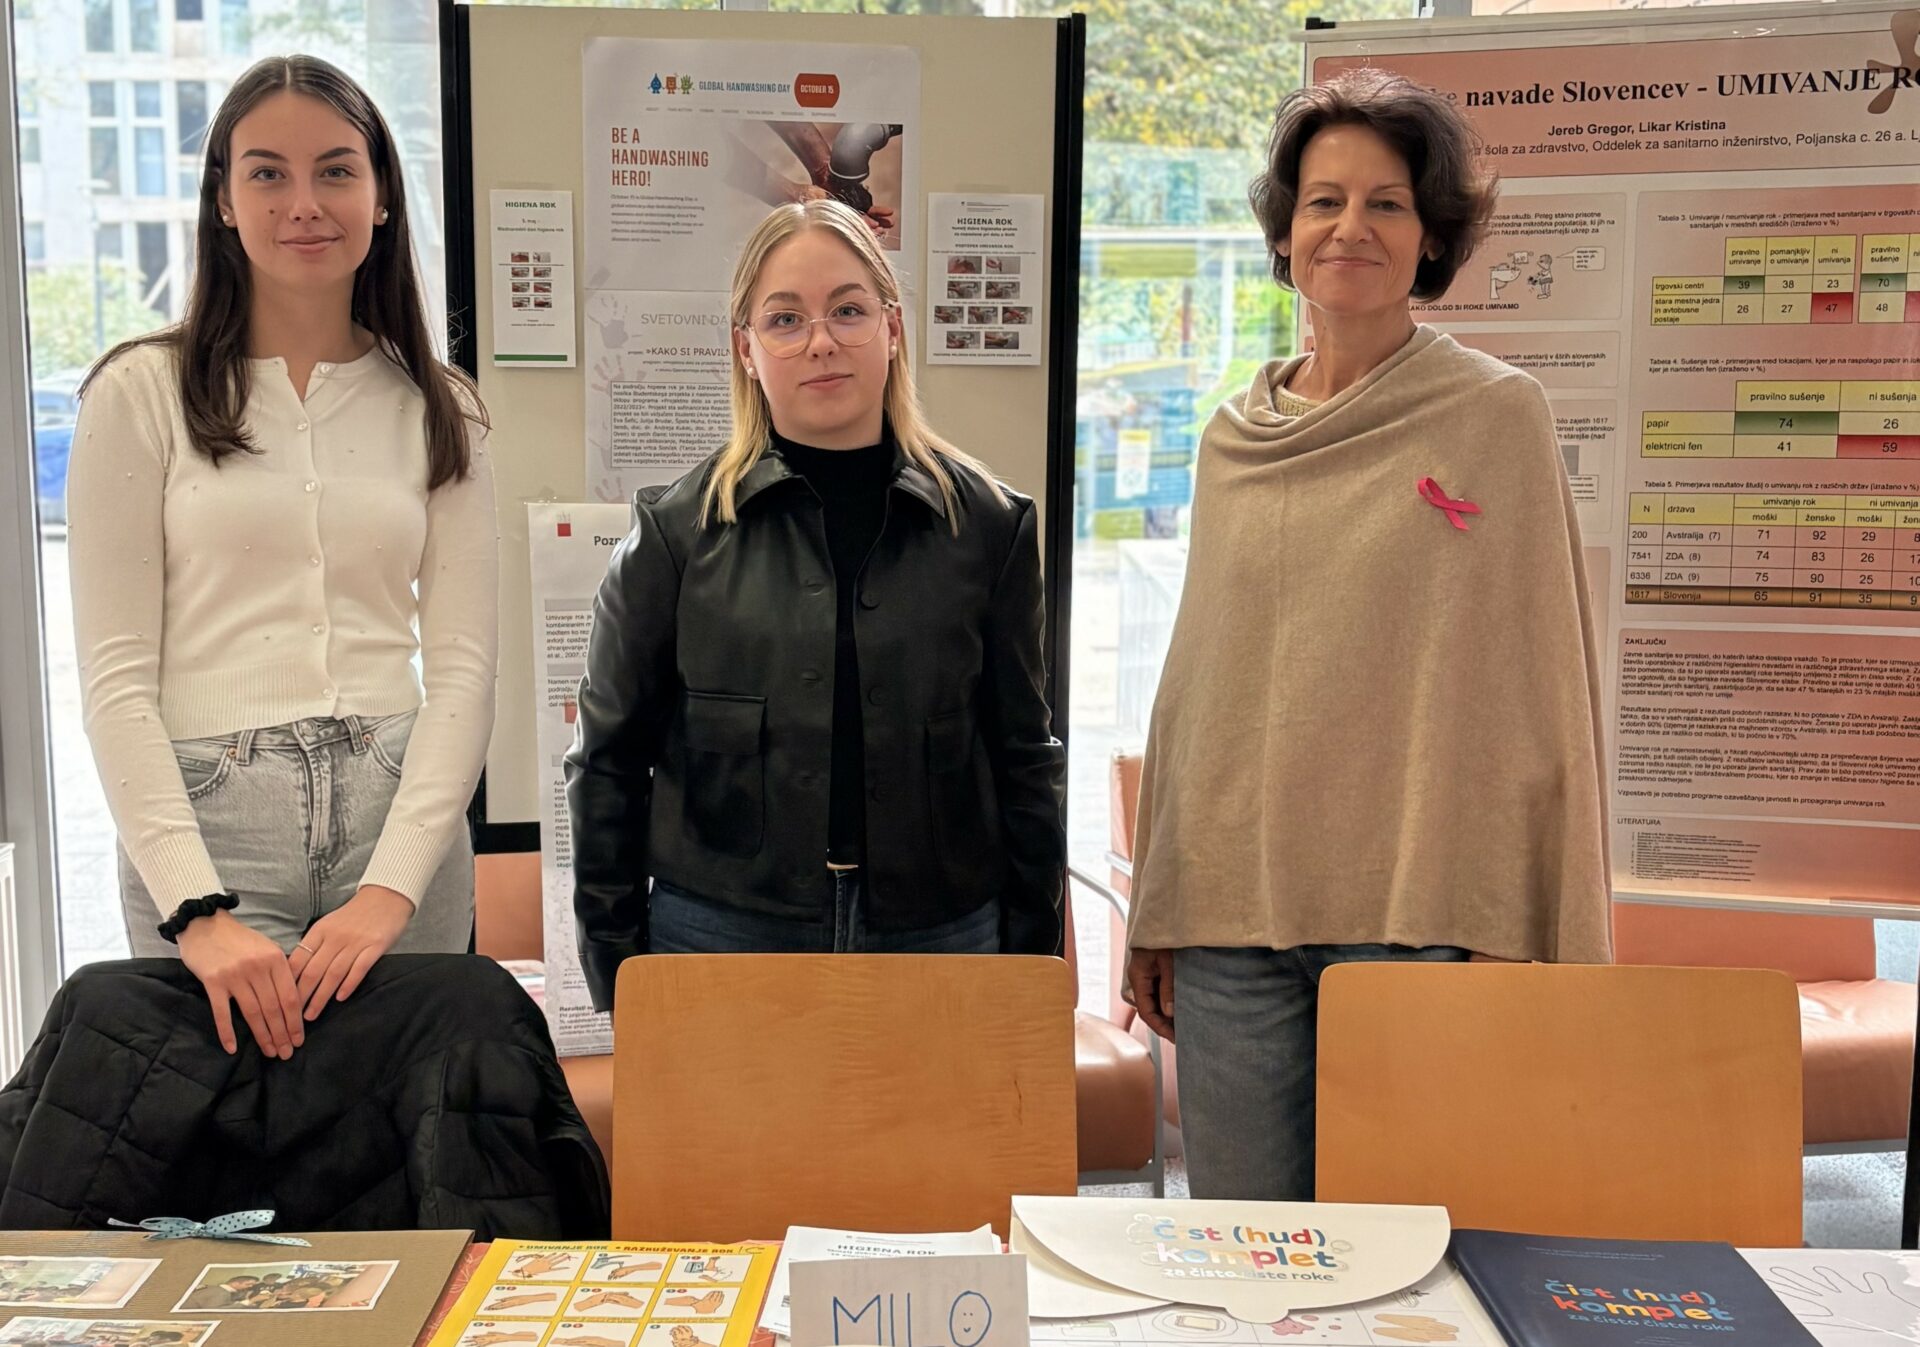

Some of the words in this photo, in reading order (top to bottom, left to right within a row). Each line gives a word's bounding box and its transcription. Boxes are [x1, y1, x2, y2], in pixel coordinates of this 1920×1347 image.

[699, 81, 724, 91] GLOBAL
[727, 82, 776, 93] HANDWASHING
[778, 84, 790, 93] DAY
[801, 85, 826, 94] OCTOBER
[1466, 83, 1555, 106] navade
[1563, 80, 1689, 102] Slovencev
[1717, 67, 1881, 97] UMIVANJE
[1890, 67, 1920, 89] R
[1548, 125, 1583, 136] Jereb
[1588, 124, 1635, 136] Gregor,
[1639, 123, 1672, 133] Likar
[1675, 120, 1726, 131] Kristina
[612, 128, 627, 143] BE
[632, 128, 640, 143] A
[1485, 144, 1508, 155] šola
[1512, 146, 1525, 154] za
[1529, 143, 1588, 154] zdravstvo,
[1593, 140, 1641, 150] Oddelek
[1646, 140, 1659, 149] za
[1663, 138, 1718, 149] sanitarno
[1723, 137, 1791, 146] inženirstvo,
[1796, 133, 1856, 146] Poljanska
[1860, 134, 1870, 143] c.
[1875, 130, 1891, 141] 26
[1895, 132, 1906, 141] a.
[612, 149, 708, 167] HANDWASHING
[612, 170, 651, 186] HERO!
[1731, 249, 1760, 257] pravilno
[1770, 248, 1810, 257] pomanjkljiv
[1729, 258, 1761, 266] umivanje
[1776, 257, 1809, 266] umivanje
[1818, 256, 1850, 264] umivanja
[1655, 281, 1682, 290] trgovski
[1685, 281, 1704, 289] centri
[1738, 281, 1750, 289] 39
[1782, 280, 1794, 289] 38
[1827, 280, 1839, 288] 23
[1878, 279, 1889, 287] 70
[1655, 297, 1673, 305] stara
[1702, 296, 1720, 305] jedra
[1663, 306, 1699, 314] avtobusne
[1737, 305, 1749, 314] 26
[1781, 304, 1793, 313] 27
[1825, 303, 1838, 312] 47
[1876, 303, 1888, 312] 48
[641, 313, 706, 325] SVETOVNI
[710, 315, 728, 325] DA
[680, 348, 690, 356] SI
[1750, 393, 1786, 402] pravilno
[1789, 392, 1825, 402] sušenje
[1869, 393, 1878, 401] ni
[1881, 393, 1917, 403] sušenja
[1647, 419, 1669, 428] papir
[1779, 418, 1793, 428] 74
[1883, 419, 1899, 429] 26
[1688, 442, 1702, 450] fen
[1777, 442, 1792, 451] 41
[1882, 442, 1897, 453] 59
[1643, 505, 1650, 513] N
[1667, 505, 1695, 514] država
[1763, 498, 1800, 506] umivanje
[1880, 500, 1918, 508] umivanja
[1752, 513, 1777, 521] moški
[1805, 514, 1835, 522] ženske
[1857, 515, 1882, 523] moški
[1632, 531, 1648, 539] 200
[1666, 531, 1703, 540] Avstralija
[1709, 531, 1721, 541] (7)
[1757, 530, 1770, 540] 71
[1812, 531, 1826, 541] 92
[1862, 531, 1876, 541] 29
[1631, 552, 1651, 560] 7541
[1665, 552, 1683, 561] ZDA
[1689, 552, 1700, 562] (8)
[1756, 550, 1769, 561] 74
[1812, 551, 1825, 562] 83
[1861, 553, 1874, 562] 26
[1630, 572, 1650, 580] 6336
[1665, 572, 1682, 581] ZDA
[1688, 572, 1700, 582] (9)
[1755, 572, 1769, 582] 75
[1811, 573, 1824, 583] 90
[1859, 575, 1873, 584] 25
[1630, 590, 1649, 599] 1617
[1754, 591, 1767, 601] 65
[1809, 592, 1822, 602] 91
[1859, 594, 1872, 603] 35
[1618, 818, 1661, 826] LITERATURA
[1233, 1226, 1326, 1246] (hud)
[837, 1245, 902, 1254] HIGIENA
[1156, 1242, 1338, 1269] komplet
[1292, 1273, 1334, 1281] roke
[1545, 1279, 1615, 1299] Čist
[1622, 1288, 1716, 1305] (hud)
[1552, 1295, 1734, 1321] komplet
[1568, 1313, 1590, 1322] za
[1594, 1316, 1640, 1326] čisto
[1644, 1318, 1689, 1329] čiste
[1692, 1323, 1735, 1332] roke
